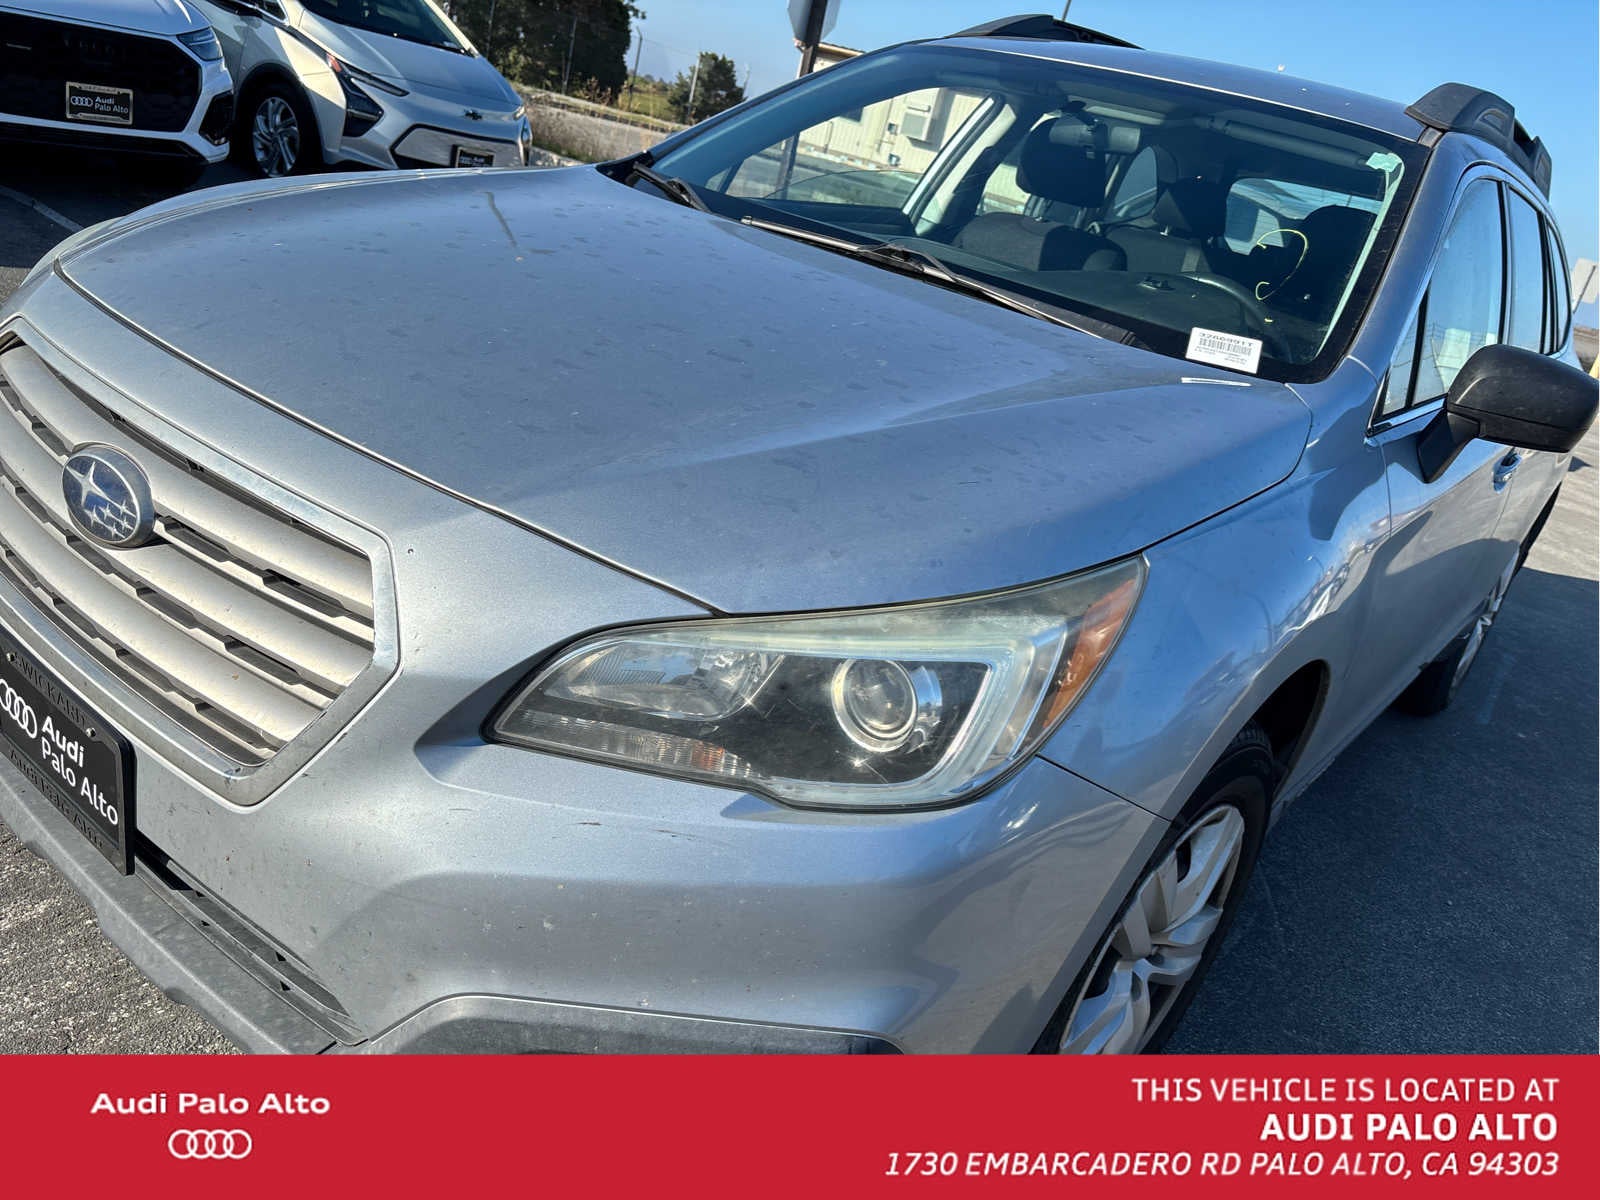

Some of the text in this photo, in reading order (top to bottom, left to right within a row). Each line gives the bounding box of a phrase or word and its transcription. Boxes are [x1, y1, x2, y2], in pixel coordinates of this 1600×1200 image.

[94, 103, 129, 114] Palo Alto
[95, 96, 115, 104] Audi
[41, 715, 84, 768] Audi
[41, 736, 118, 826] Palo Alto
